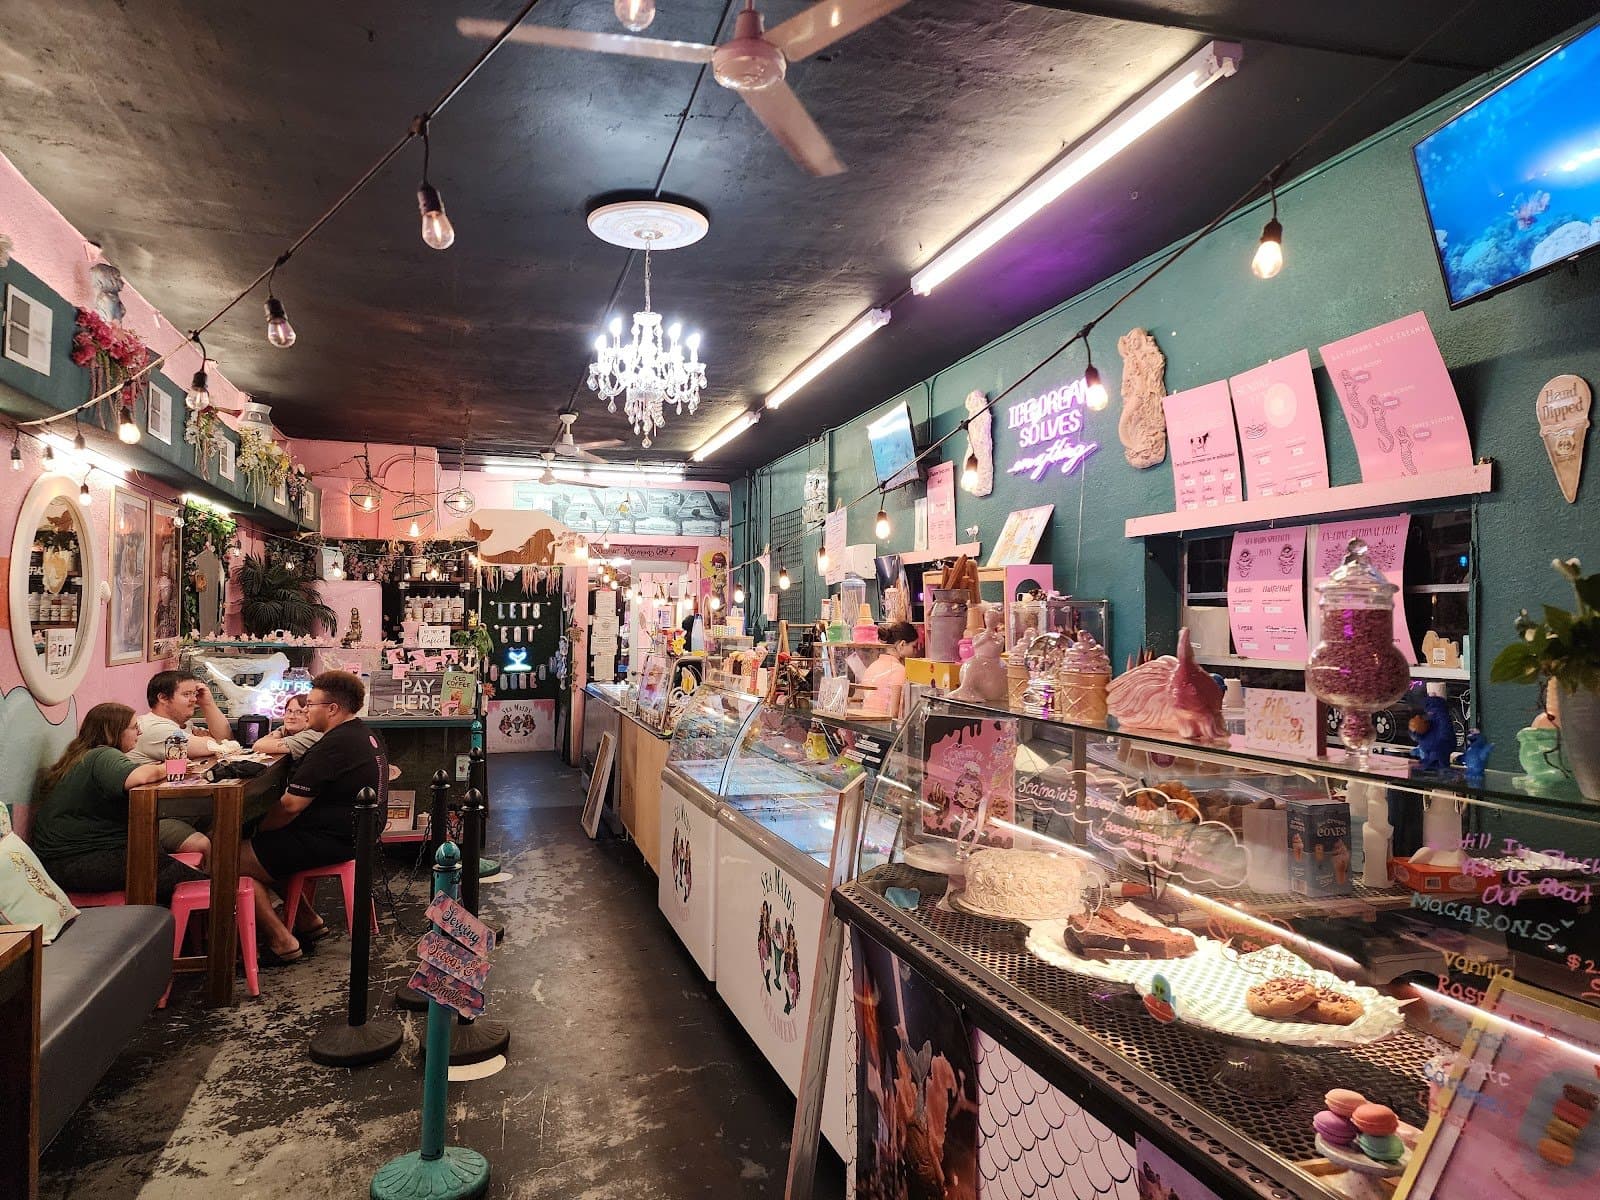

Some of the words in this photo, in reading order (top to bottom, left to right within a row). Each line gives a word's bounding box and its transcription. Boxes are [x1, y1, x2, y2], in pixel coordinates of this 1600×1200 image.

[1545, 382, 1578, 403] Hand
[1542, 396, 1584, 422] Dipped
[1019, 409, 1082, 448] SOLVES
[270, 681, 291, 691] BUT
[294, 681, 313, 691] FIR
[401, 679, 436, 694] PAY
[446, 680, 471, 689] COFFEE
[393, 695, 441, 710] HERE
[761, 871, 774, 897] SEA
[774, 866, 798, 922] MAIDS
[442, 904, 480, 946] Serving
[463, 960, 479, 977] &
[1442, 950, 1514, 979] Vanilla
